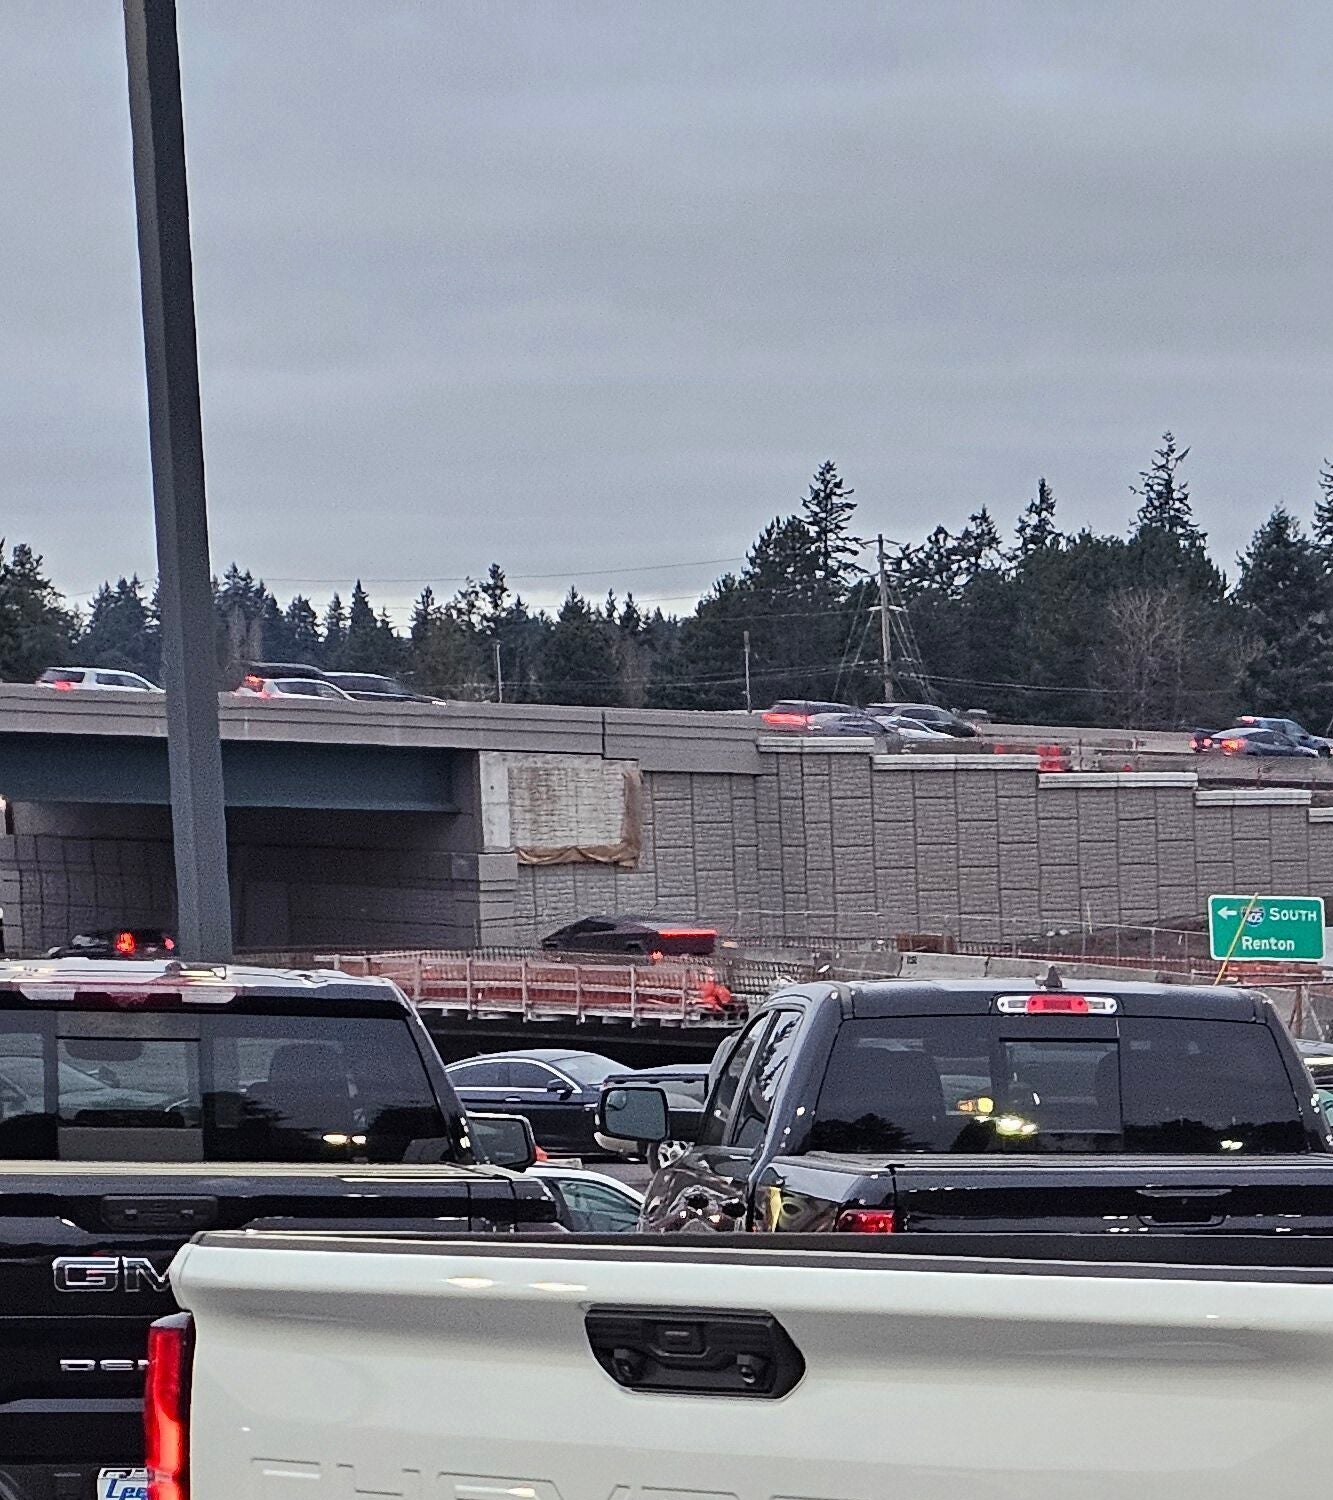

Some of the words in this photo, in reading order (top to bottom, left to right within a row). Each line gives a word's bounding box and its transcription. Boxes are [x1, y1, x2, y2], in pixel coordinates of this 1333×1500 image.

[1270, 907, 1317, 922] SOUTH
[1242, 936, 1295, 952] Renton
[52, 1256, 170, 1293] GM
